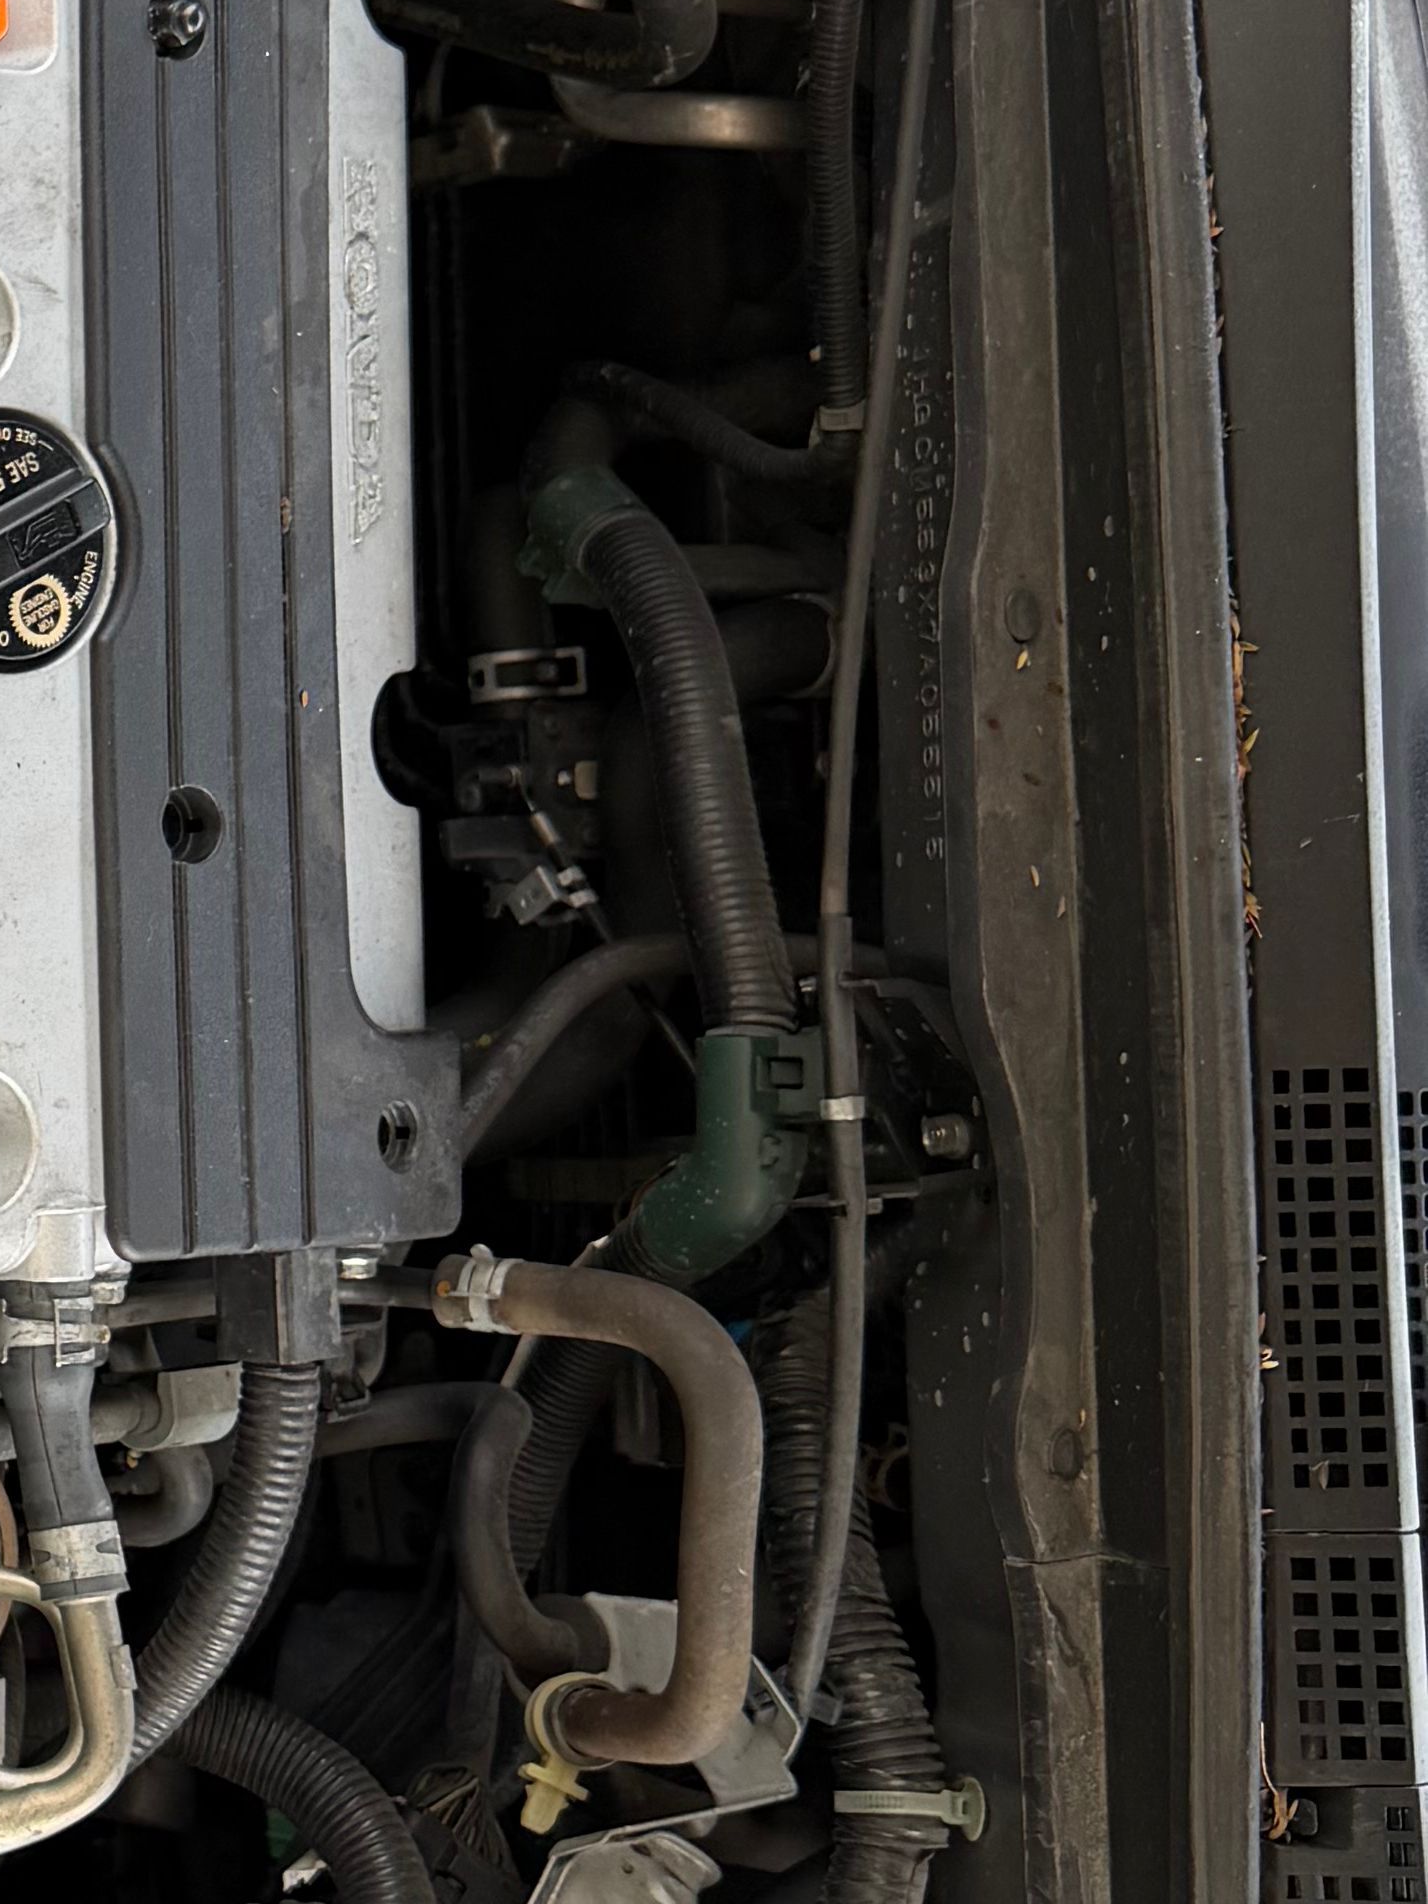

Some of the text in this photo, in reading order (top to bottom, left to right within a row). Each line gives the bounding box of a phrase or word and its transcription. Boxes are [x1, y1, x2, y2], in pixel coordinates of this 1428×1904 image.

[344, 157, 382, 548] HONDA
[15, 428, 38, 446] SEE
[4, 452, 40, 484] SAE
[70, 550, 98, 609] ENGINE
